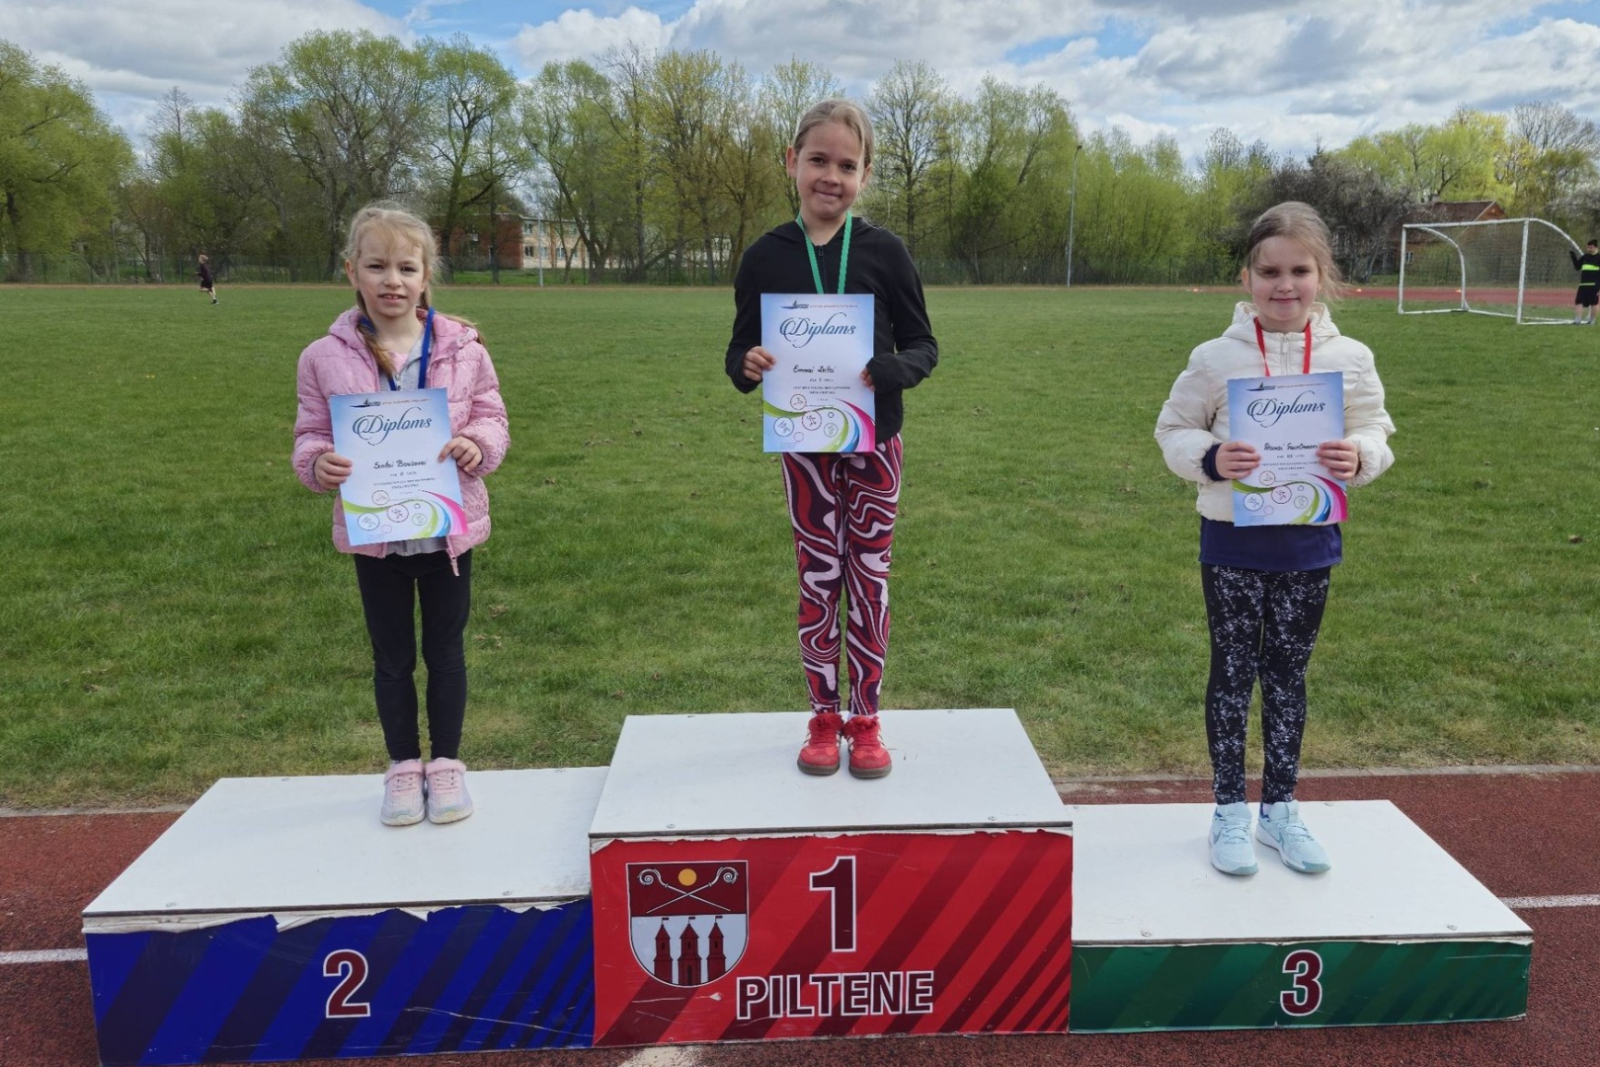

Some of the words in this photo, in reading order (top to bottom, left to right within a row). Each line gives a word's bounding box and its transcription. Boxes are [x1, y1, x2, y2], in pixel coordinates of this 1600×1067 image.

[779, 311, 857, 349] Diploms
[352, 406, 432, 446] Diploms
[1246, 390, 1326, 429] Diploms
[809, 855, 856, 953] 1
[322, 948, 371, 1019] 2
[736, 970, 935, 1020] PILTENE
[1280, 949, 1323, 1017] 3
